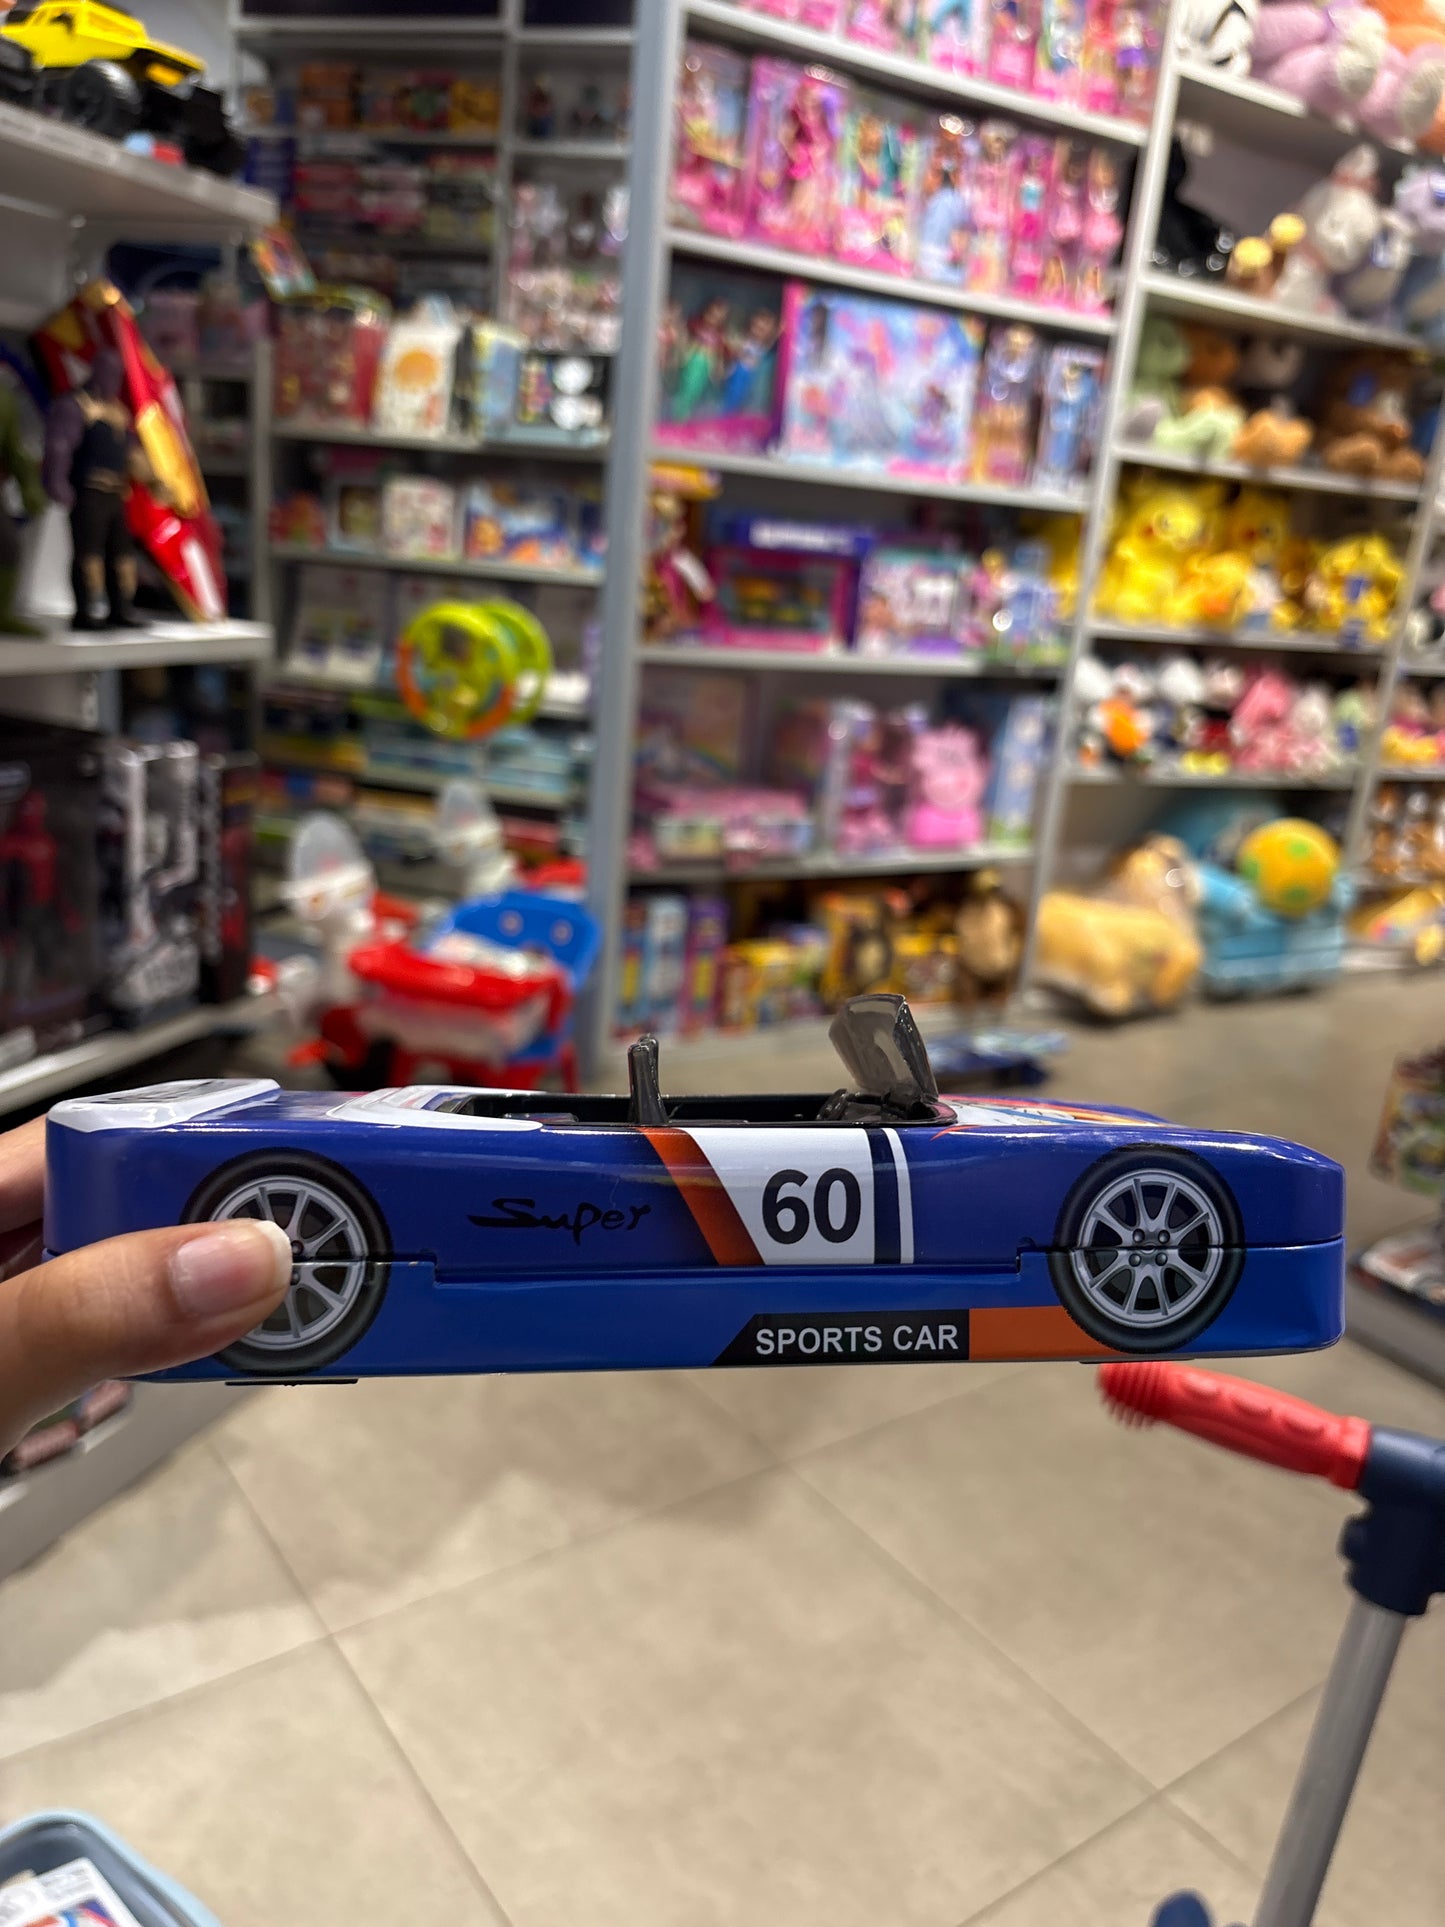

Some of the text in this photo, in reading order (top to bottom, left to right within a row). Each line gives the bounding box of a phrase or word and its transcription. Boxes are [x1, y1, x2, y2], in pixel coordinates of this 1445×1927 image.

[466, 1197, 651, 1246] Super
[762, 1168, 861, 1244] 60
[755, 1324, 959, 1355] SPORTS CAR
